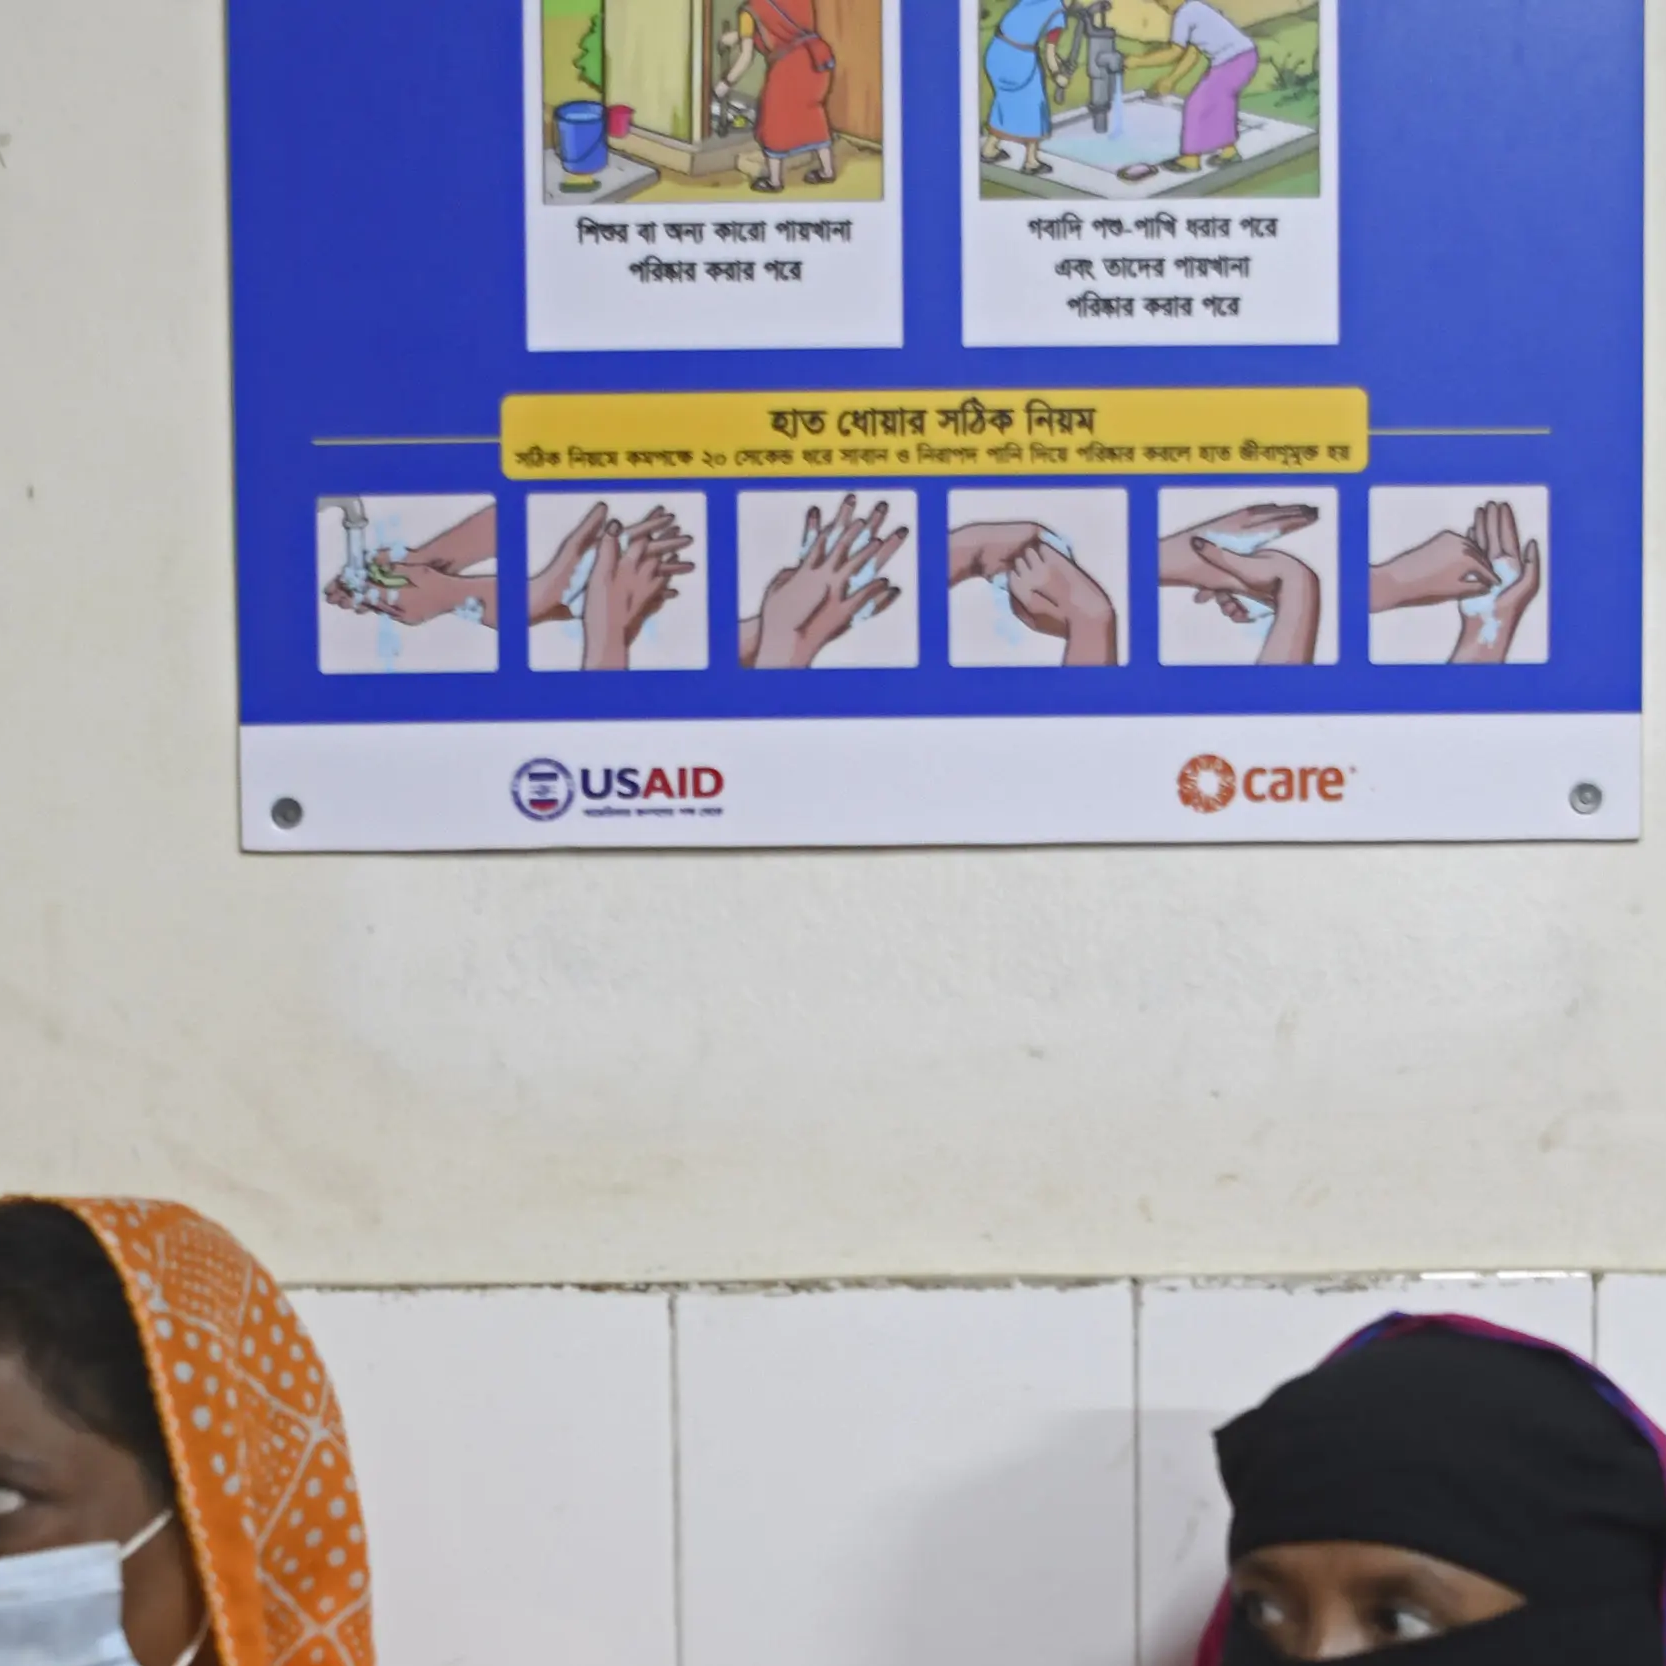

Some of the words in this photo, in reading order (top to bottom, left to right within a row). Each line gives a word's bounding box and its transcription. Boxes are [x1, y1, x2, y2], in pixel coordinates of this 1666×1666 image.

[576, 216, 629, 245] শিশুর
[636, 221, 658, 245] বা
[663, 221, 706, 244] অন্য
[712, 219, 767, 244] কারো
[775, 219, 852, 243] পায়খানা
[1028, 212, 1084, 240] গবাদি
[1186, 216, 1232, 239] ধরার
[1239, 216, 1279, 239] পরে
[704, 259, 756, 283] করার
[763, 258, 803, 282] পরে
[1054, 256, 1097, 281] এবং
[1102, 256, 1165, 280] তাদের
[1173, 255, 1251, 280] পায়খানা
[1143, 295, 1194, 318] করার
[1202, 294, 1241, 318] পরে
[768, 406, 828, 440] হাত
[837, 405, 928, 439] ধোয়ার
[936, 397, 1015, 437] সঠিক
[1024, 399, 1097, 437] নিয়ম
[514, 446, 561, 468] সঠিক
[701, 450, 728, 468] ২০
[802, 448, 833, 467] ধরে
[839, 448, 888, 466] সাবান
[896, 449, 911, 465] ও
[985, 442, 1023, 465] পানি
[1198, 444, 1231, 464] হাত
[581, 767, 725, 800] USAID
[1242, 766, 1345, 803] care
